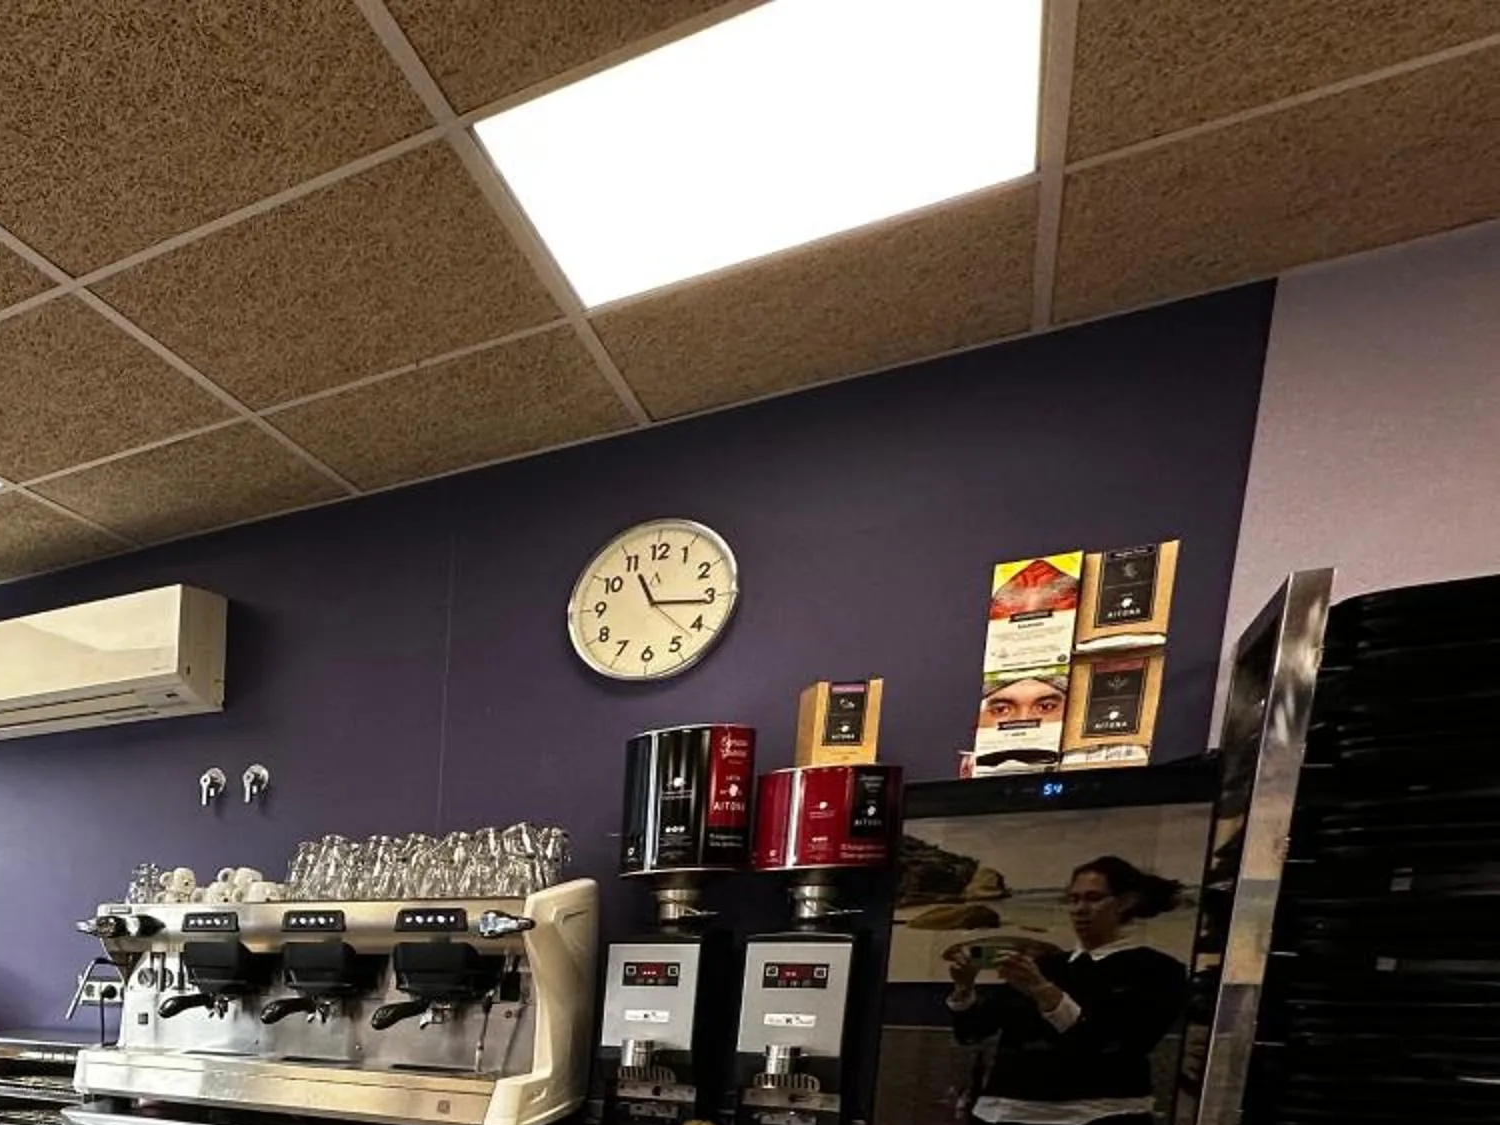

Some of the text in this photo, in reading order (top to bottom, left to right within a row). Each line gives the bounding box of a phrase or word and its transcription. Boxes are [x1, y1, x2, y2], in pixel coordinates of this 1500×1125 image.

[650, 543, 671, 561] 12
[681, 545, 689, 564] 1
[625, 554, 639, 572] 11
[698, 562, 711, 579] 2
[604, 576, 624, 594] 10
[704, 587, 715, 604] 3
[595, 601, 607, 618] 9
[690, 615, 703, 632] 4
[599, 626, 610, 643] 8
[616, 639, 629, 657] 7
[668, 635, 683, 652] 5
[641, 646, 654, 662] 6
